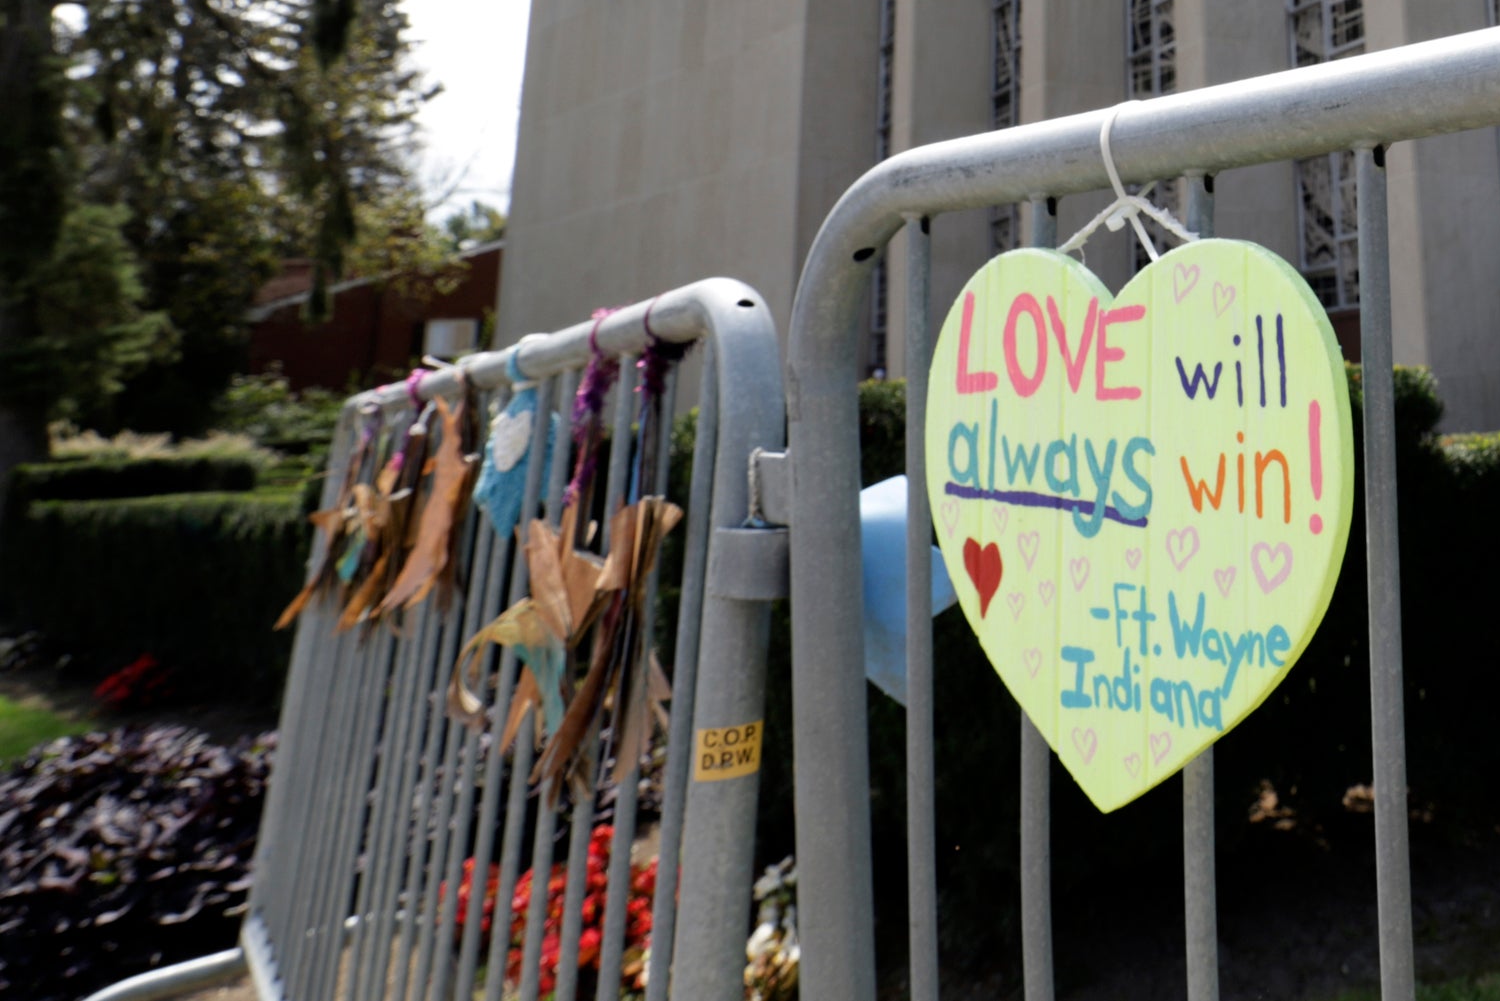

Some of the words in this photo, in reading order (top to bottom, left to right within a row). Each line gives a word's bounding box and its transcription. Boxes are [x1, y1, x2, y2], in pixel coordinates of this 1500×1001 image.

[955, 291, 1147, 401] LOVE
[1174, 313, 1288, 408] will
[948, 398, 1157, 538] always
[1059, 644, 1225, 733] Indiana
[1168, 589, 1292, 700] Wayne
